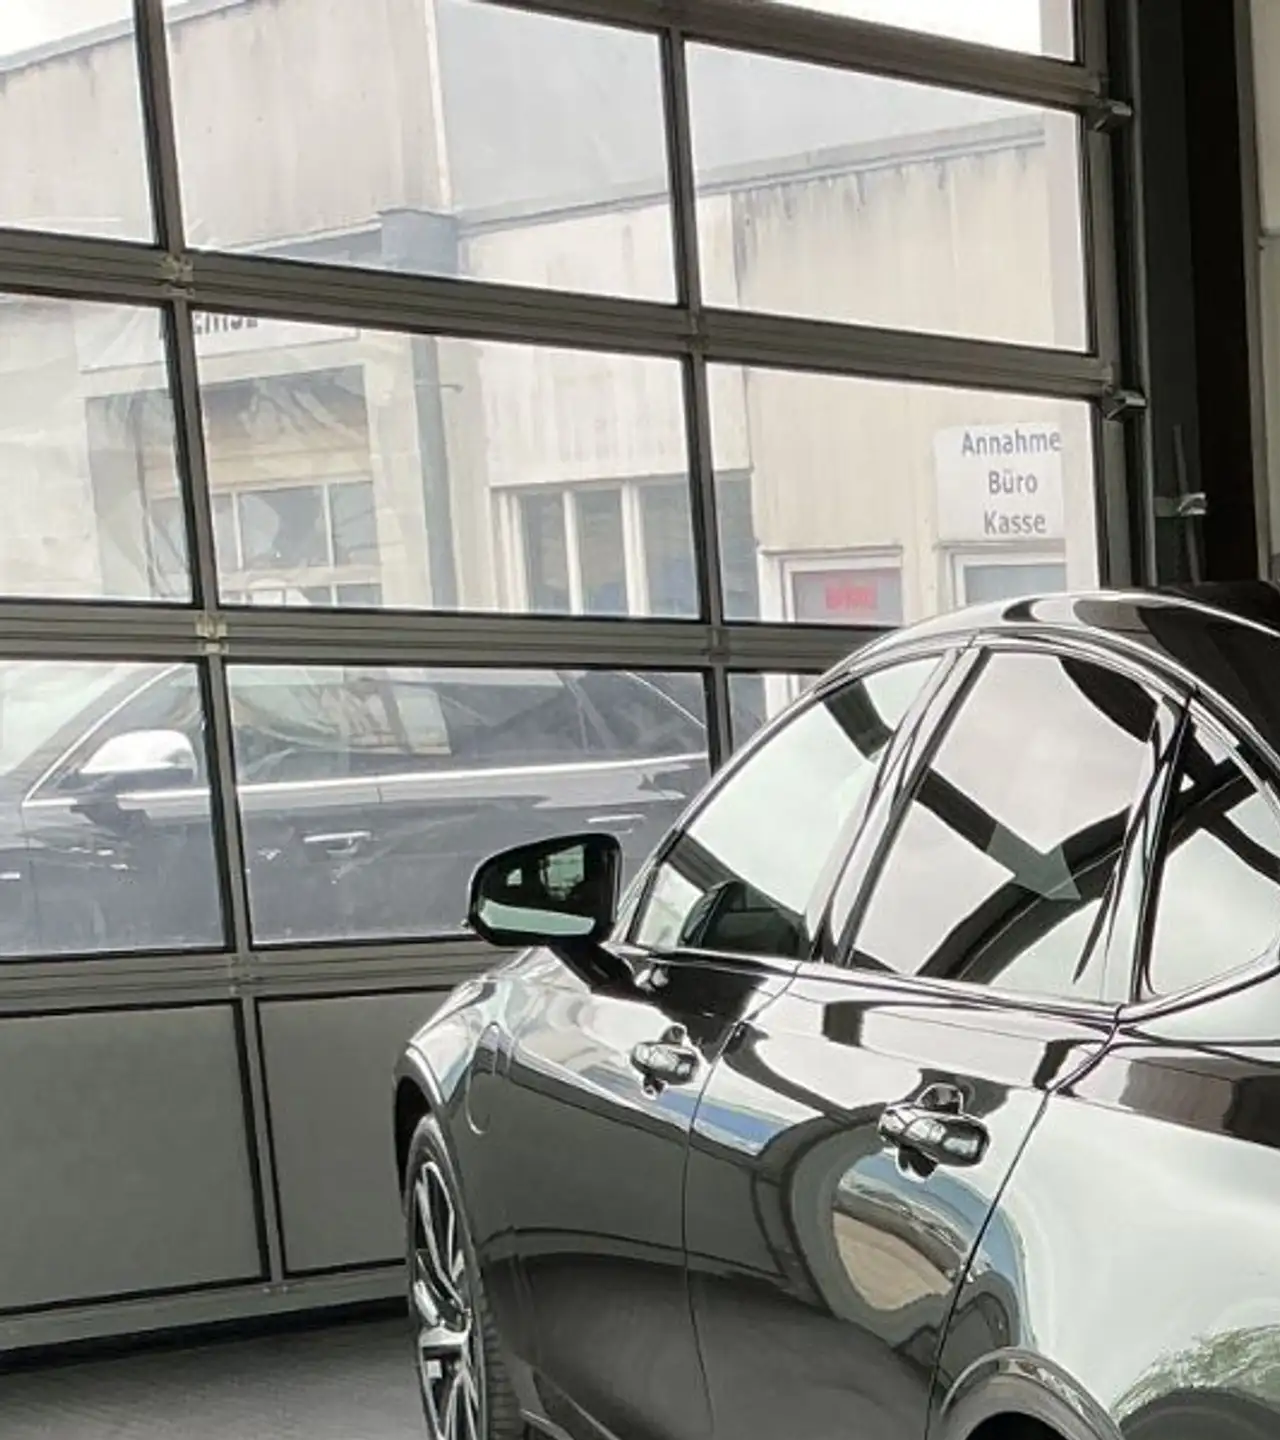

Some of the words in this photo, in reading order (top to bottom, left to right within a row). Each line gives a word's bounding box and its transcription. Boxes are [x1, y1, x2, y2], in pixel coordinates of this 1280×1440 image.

[961, 430, 1063, 456] Annahme
[988, 470, 1038, 495] Büro
[984, 511, 1047, 535] Kasse
